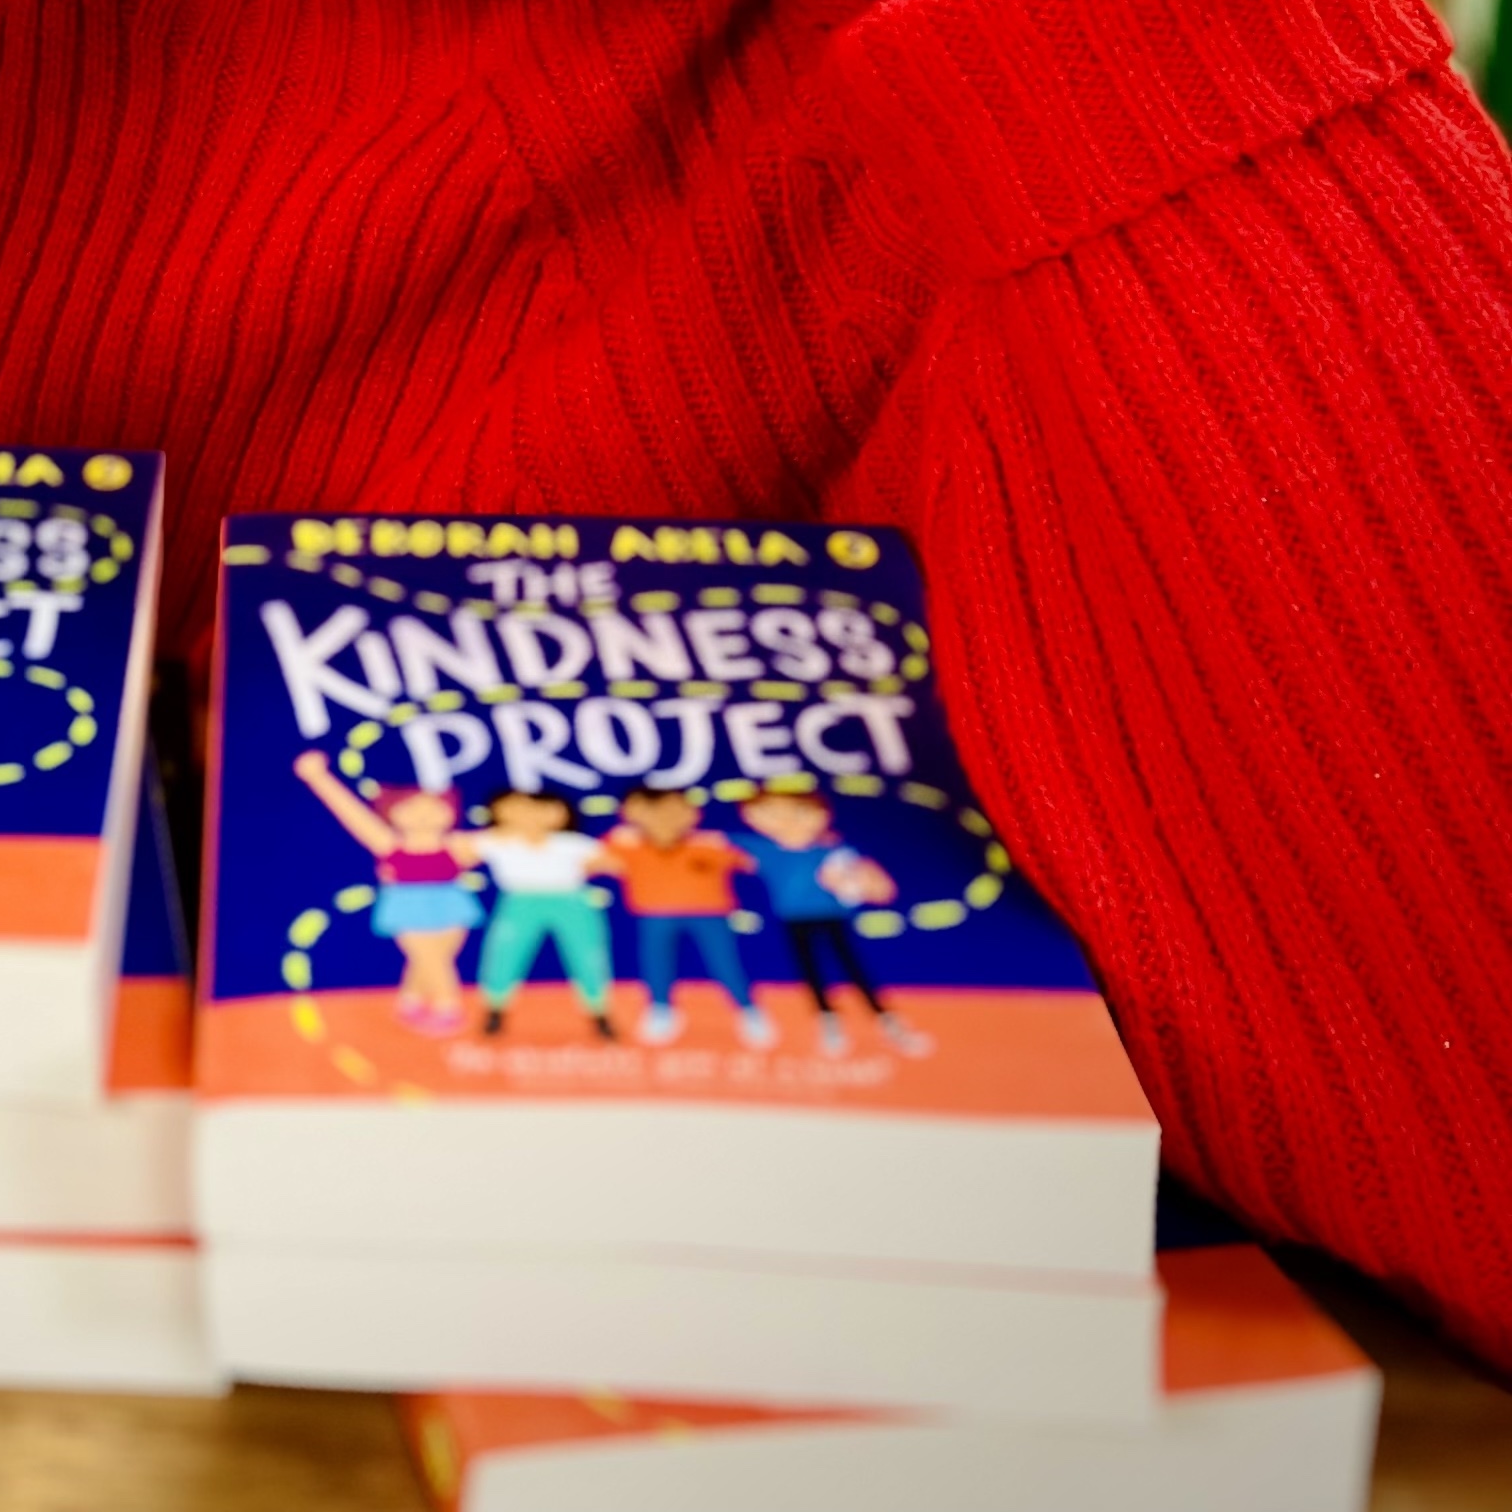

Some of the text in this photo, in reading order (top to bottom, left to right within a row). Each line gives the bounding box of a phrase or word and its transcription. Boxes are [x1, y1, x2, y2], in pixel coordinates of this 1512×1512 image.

[292, 518, 580, 559] DEBORAH
[467, 557, 620, 609] THE
[260, 600, 895, 739] KINDNESS
[401, 691, 915, 794] PROJECT
